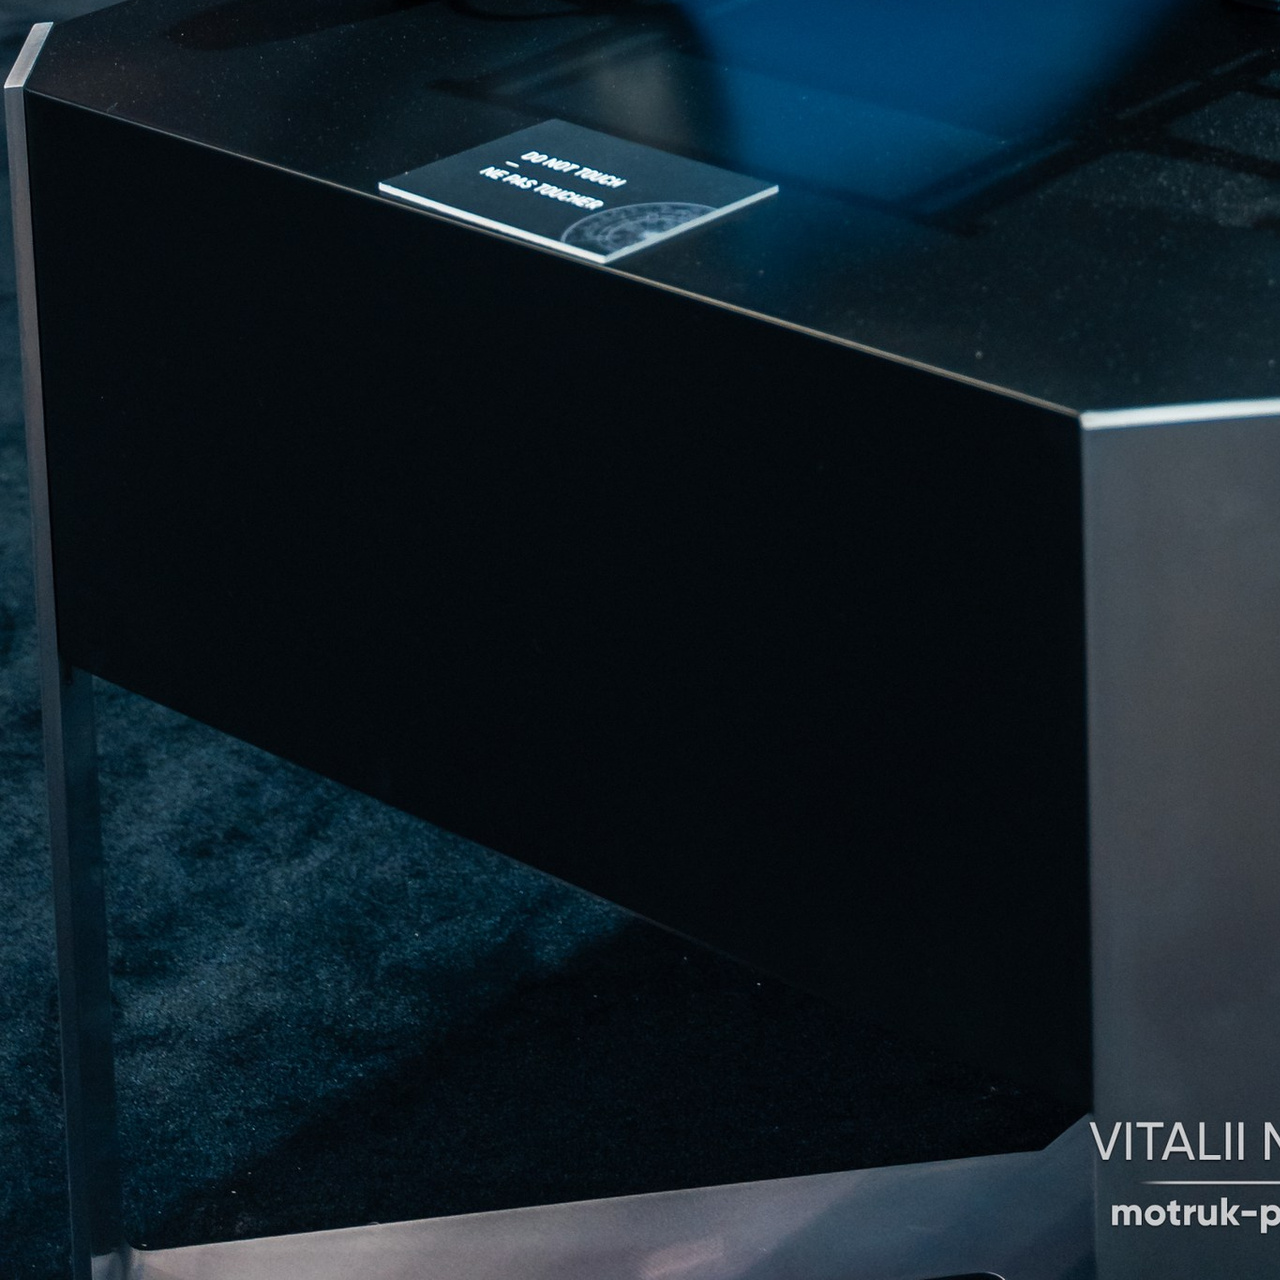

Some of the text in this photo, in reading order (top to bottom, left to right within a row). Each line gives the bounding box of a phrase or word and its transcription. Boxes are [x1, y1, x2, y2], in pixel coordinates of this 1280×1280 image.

[479, 166, 604, 210] NE PAS TOUCHER
[521, 151, 627, 188] DO NOT TOUCH
